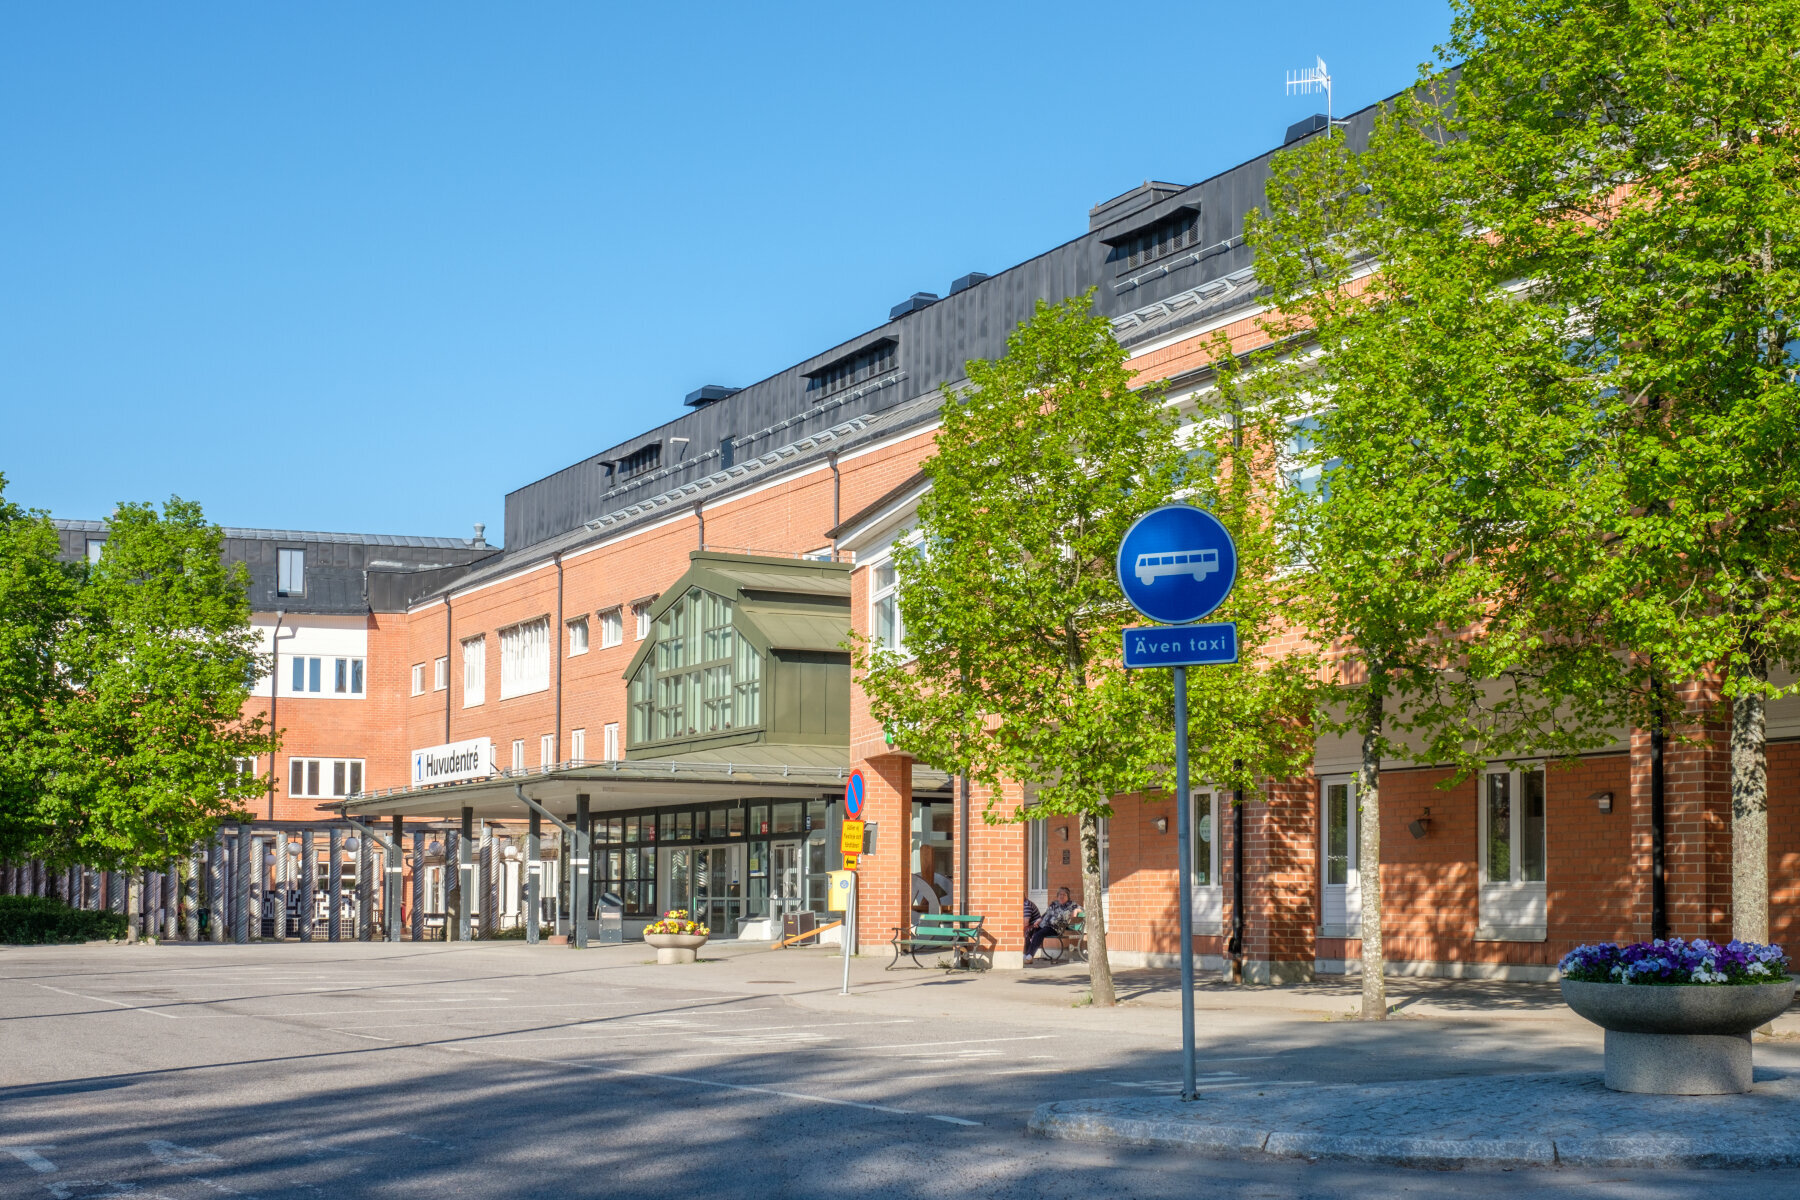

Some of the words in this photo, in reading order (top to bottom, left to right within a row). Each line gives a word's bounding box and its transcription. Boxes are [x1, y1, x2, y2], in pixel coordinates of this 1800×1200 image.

[1135, 637, 1181, 654] Även
[1190, 636, 1226, 651] taxi
[417, 756, 422, 780] 1
[426, 745, 479, 777] Huvudentré
